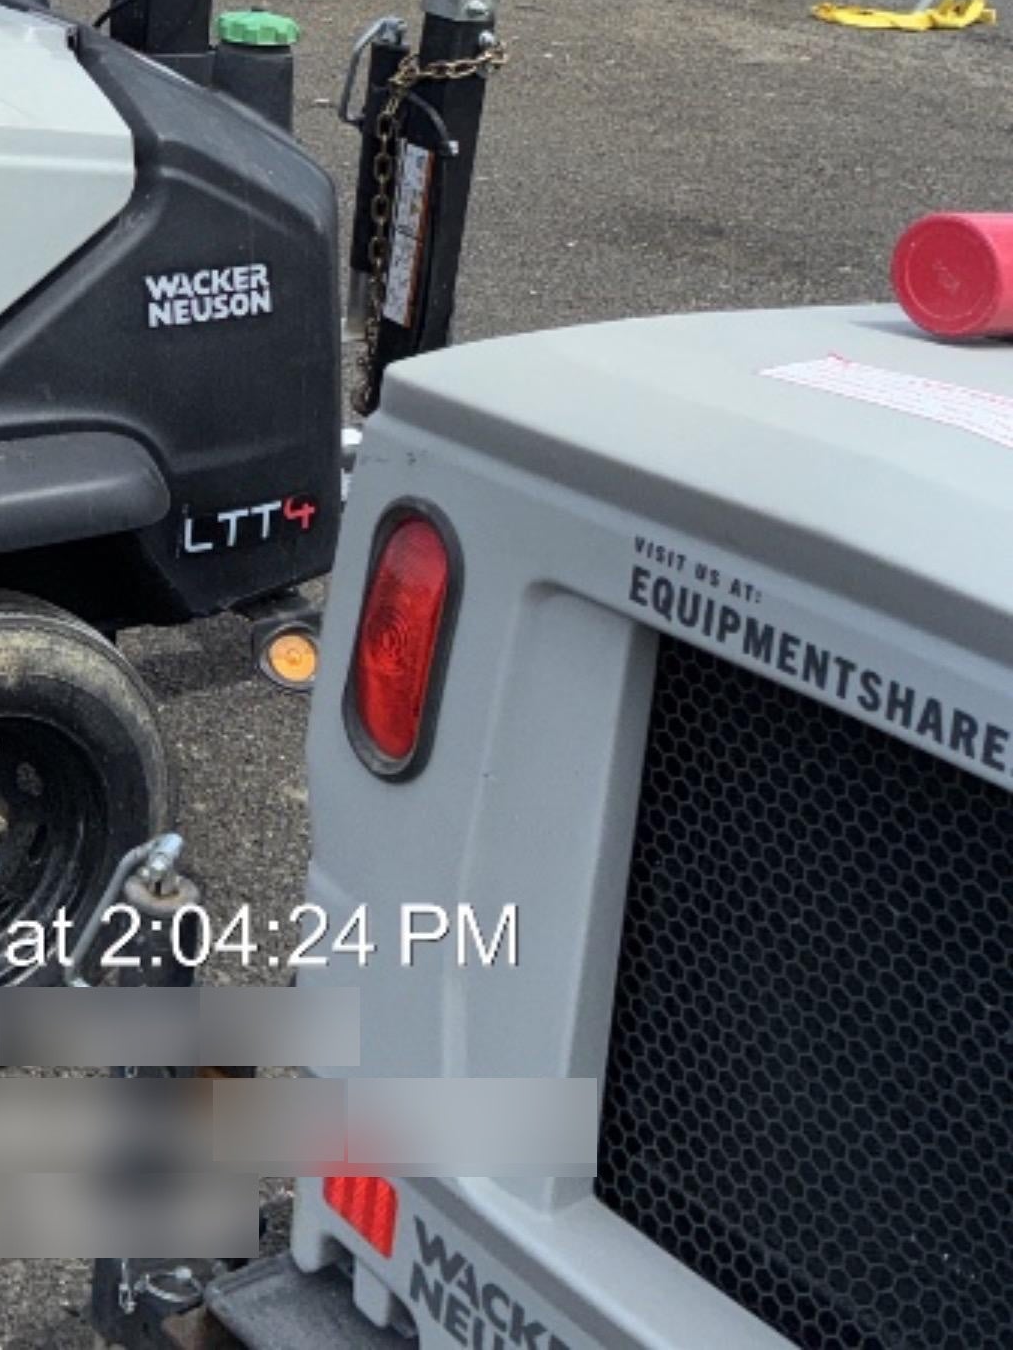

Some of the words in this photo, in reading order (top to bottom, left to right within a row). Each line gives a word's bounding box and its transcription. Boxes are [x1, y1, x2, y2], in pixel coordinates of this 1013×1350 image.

[144, 263, 269, 301] WACKER
[148, 289, 272, 328] NEUSON
[184, 497, 315, 552] LTT4
[635, 536, 686, 571] VISIT
[695, 562, 720, 588] US
